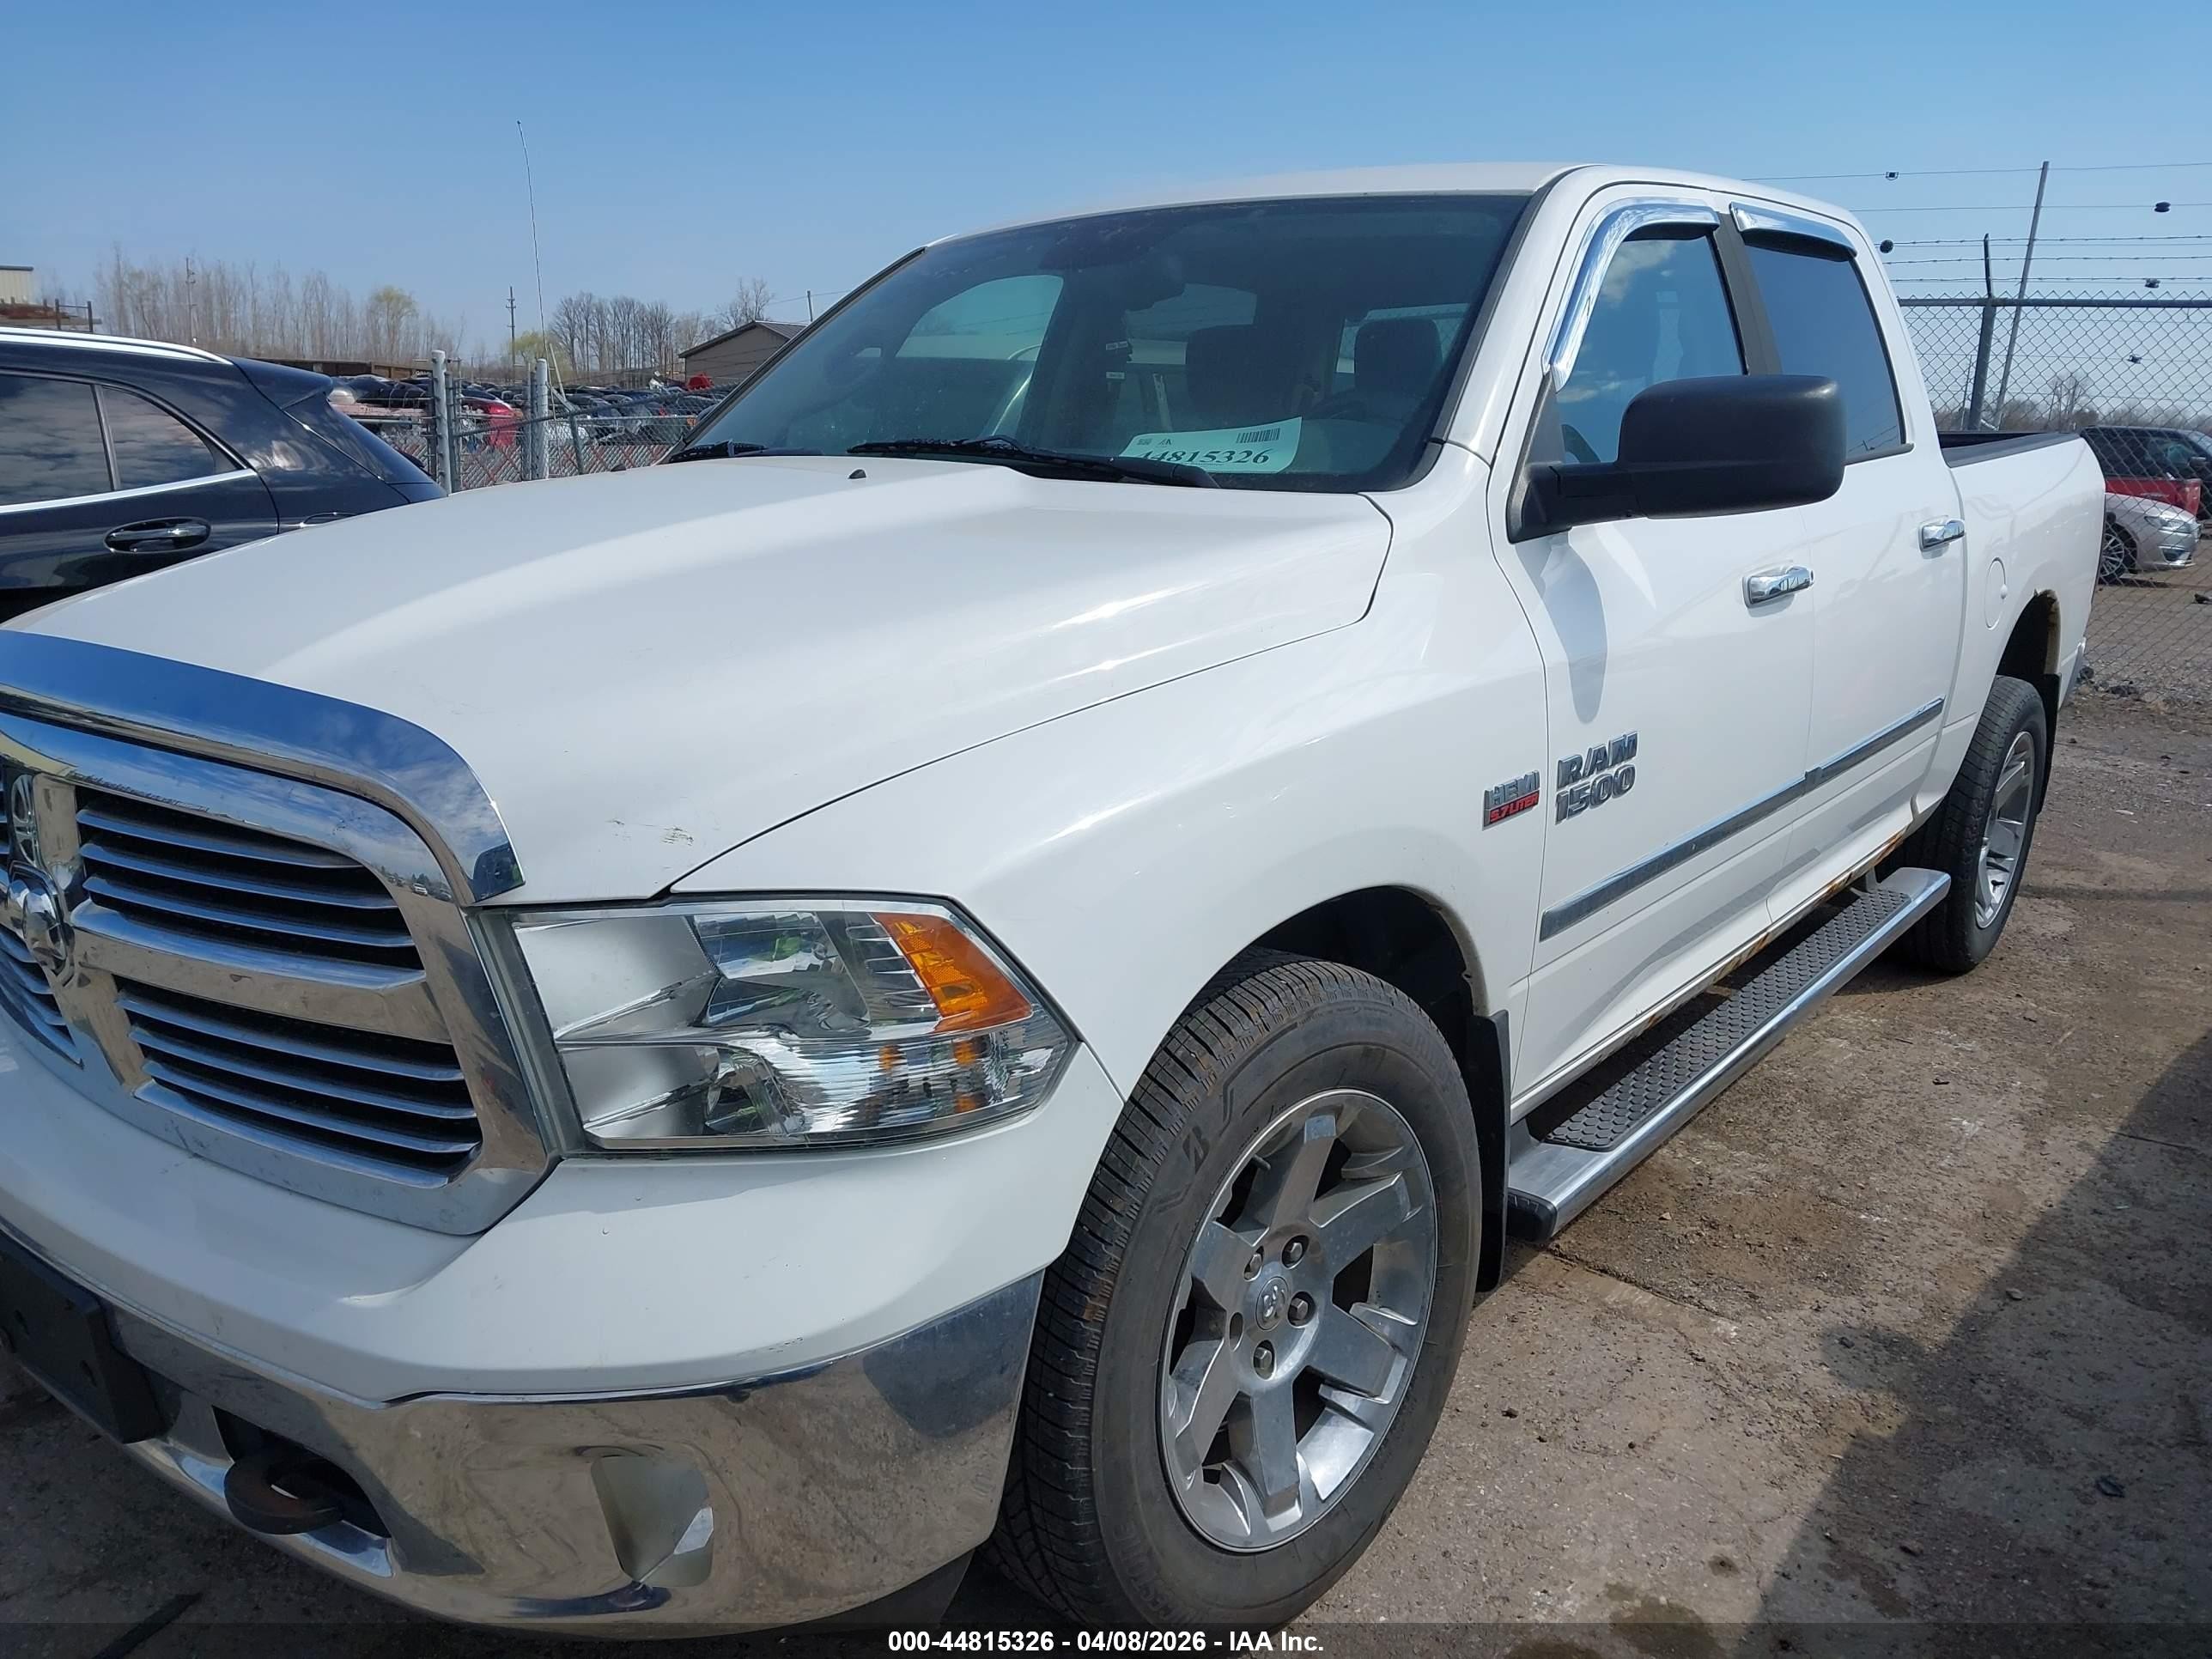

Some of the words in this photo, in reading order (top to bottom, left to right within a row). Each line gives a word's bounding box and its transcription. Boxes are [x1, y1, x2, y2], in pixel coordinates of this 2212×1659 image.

[1556, 731, 1638, 789] RAM
[1484, 771, 1540, 811] HEMI
[1554, 763, 1637, 824] 1500
